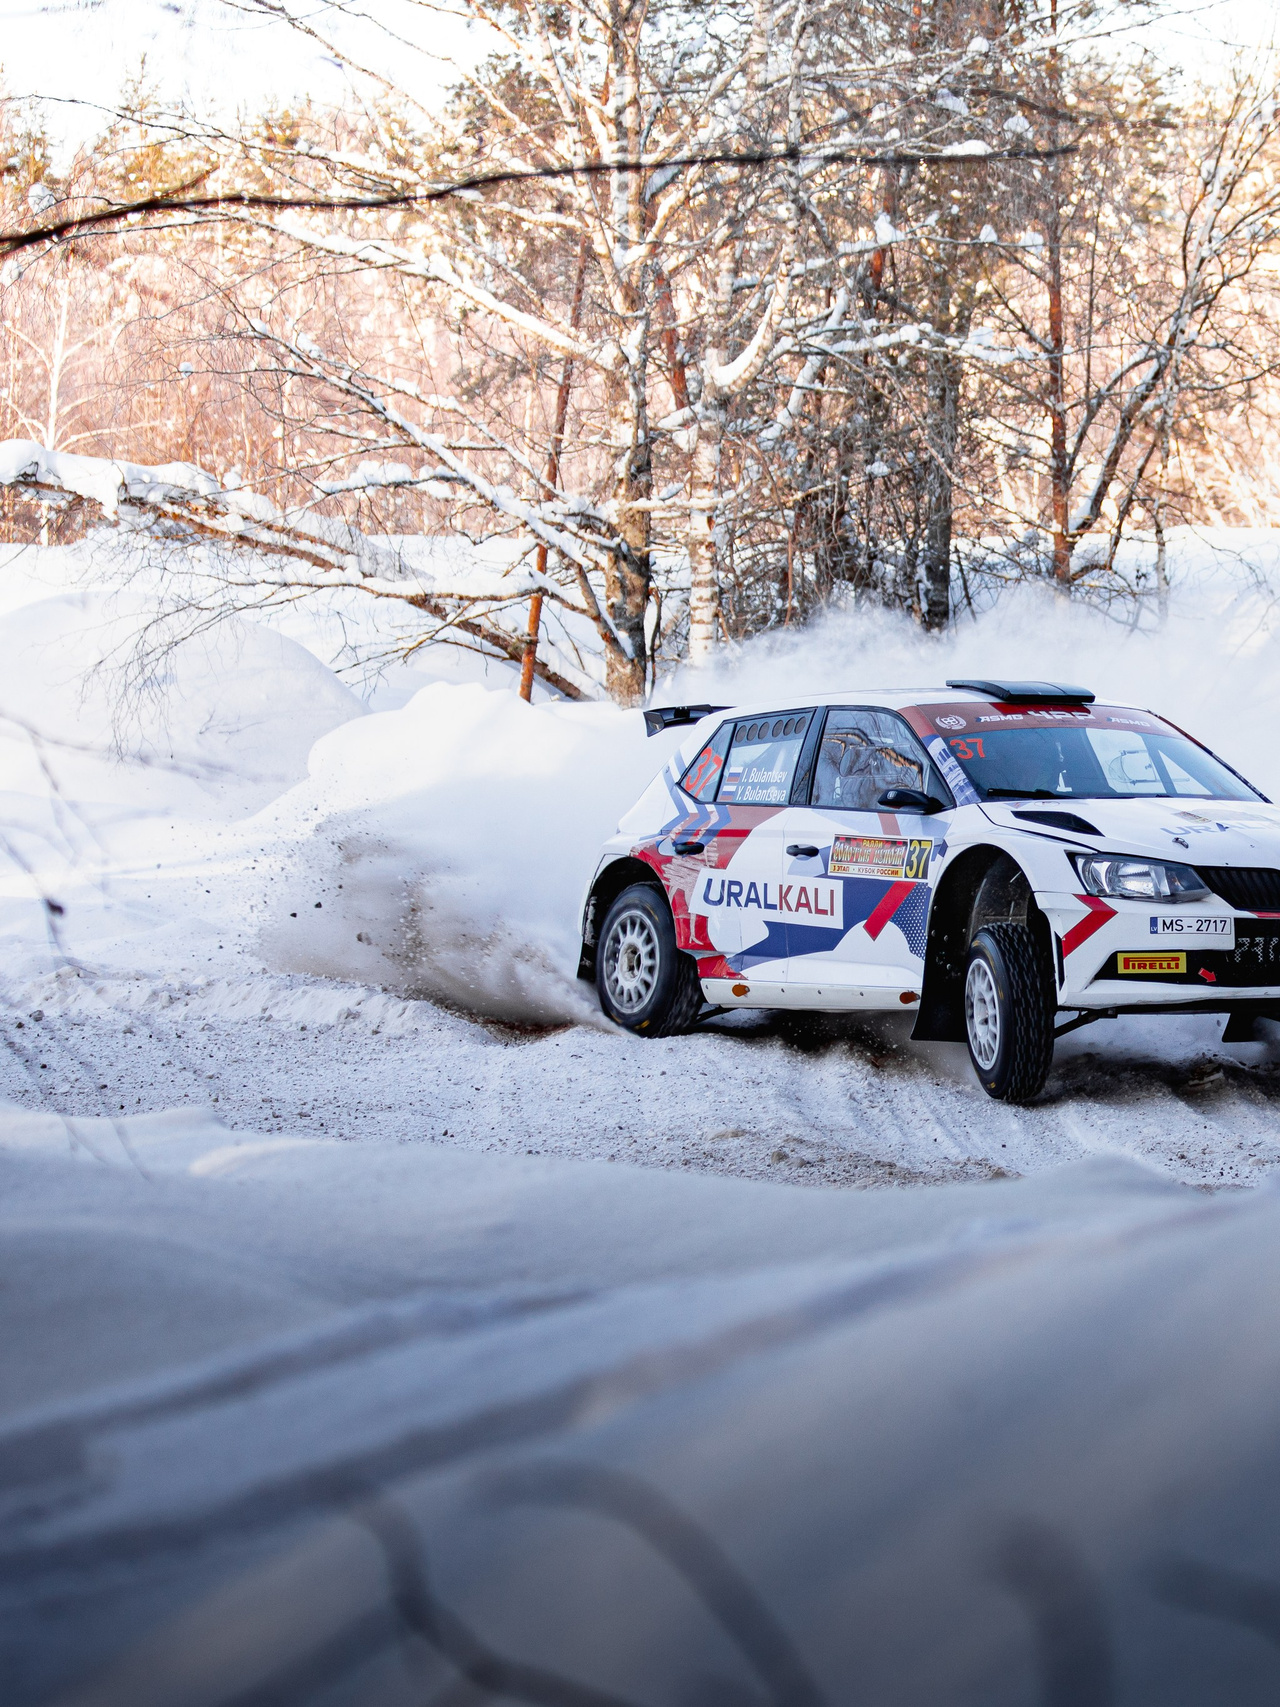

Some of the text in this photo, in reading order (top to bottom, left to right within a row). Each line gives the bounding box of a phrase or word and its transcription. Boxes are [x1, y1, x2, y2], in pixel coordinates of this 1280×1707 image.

[950, 738, 986, 760] 37
[684, 747, 723, 798] 37
[749, 768, 787, 783] Bulantsev
[744, 786, 786, 801] Bulantseva
[905, 840, 932, 878] 37
[876, 868, 899, 876] РОССИИ
[703, 878, 835, 916] URALKALI
[1123, 957, 1181, 970] PIRELLI
